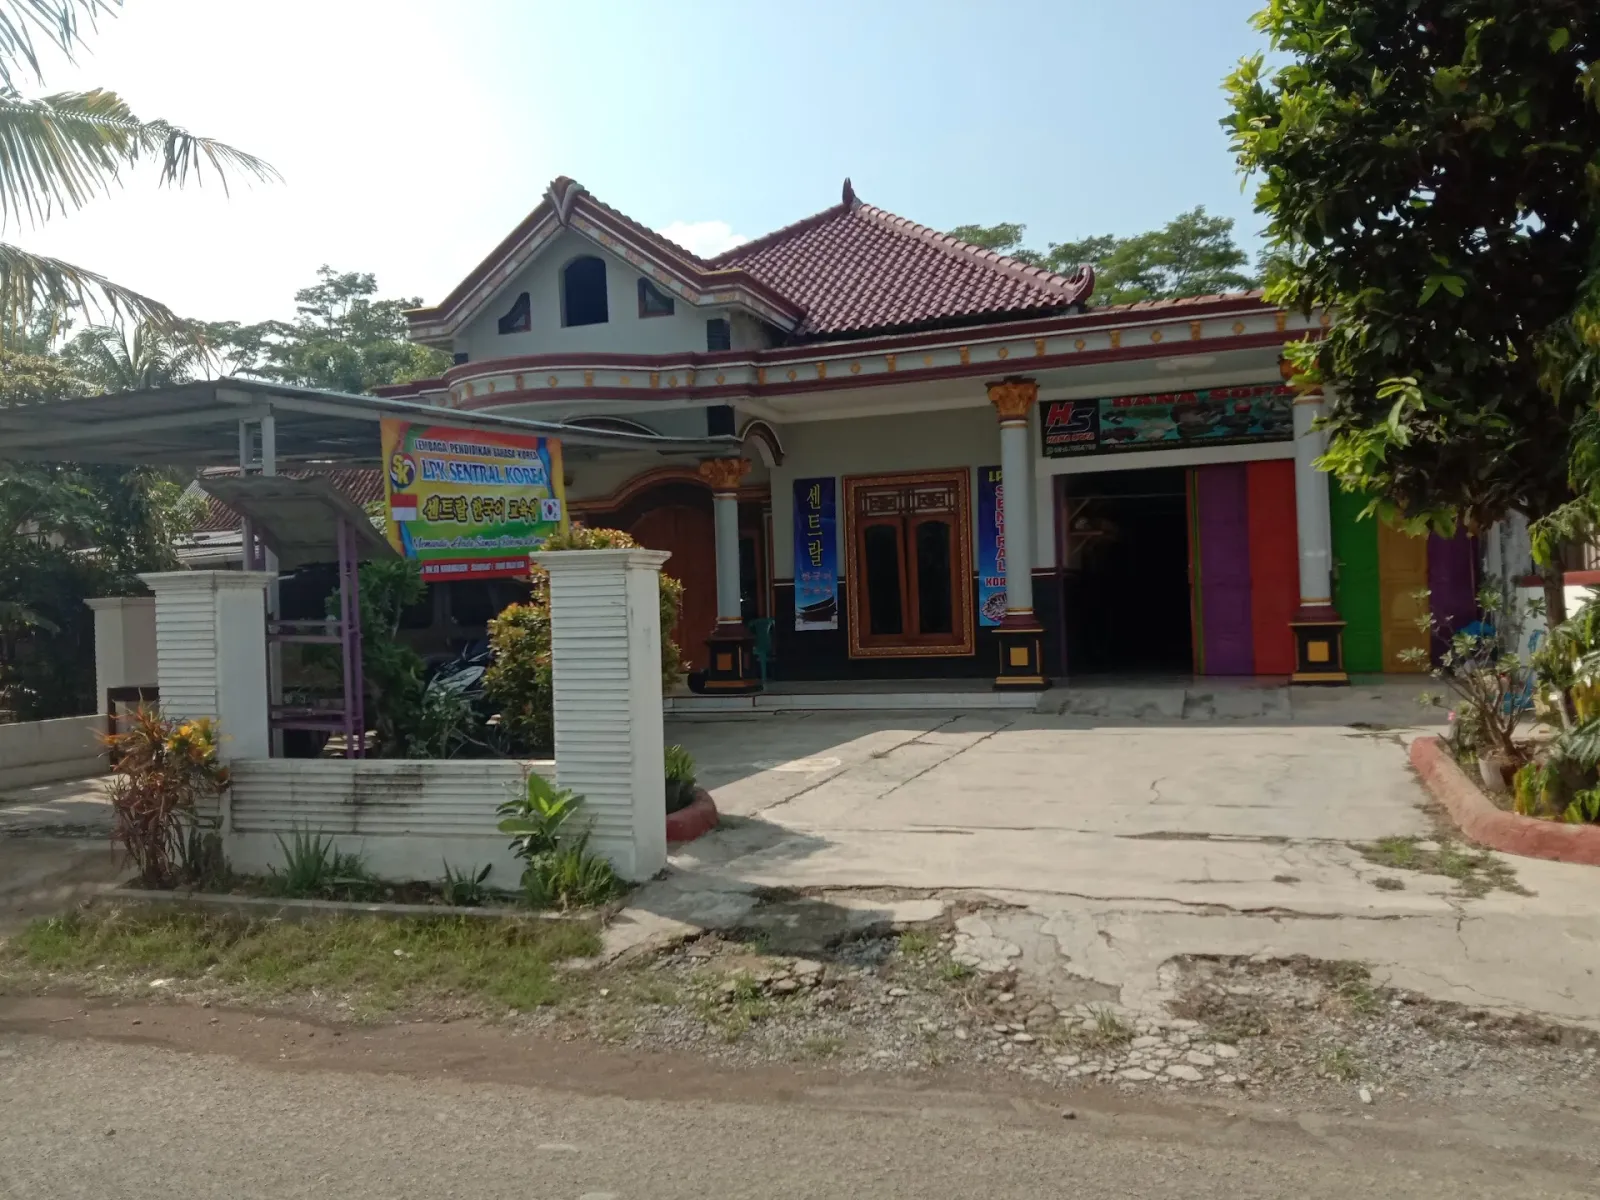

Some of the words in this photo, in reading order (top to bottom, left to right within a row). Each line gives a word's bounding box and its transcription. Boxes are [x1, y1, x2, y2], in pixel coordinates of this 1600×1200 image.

[415, 439, 448, 452] LEMBAGA
[450, 443, 491, 456] PENDIDIKAN
[492, 447, 515, 458] BAHASA
[517, 450, 539, 460] KOREA
[392, 454, 409, 484] SK
[421, 459, 448, 480] LPK
[449, 462, 504, 483] SENTRAL
[505, 466, 544, 485] KOREA
[988, 470, 1003, 483] LP
[471, 496, 505, 523] 한국어
[985, 577, 1006, 587] KOR
